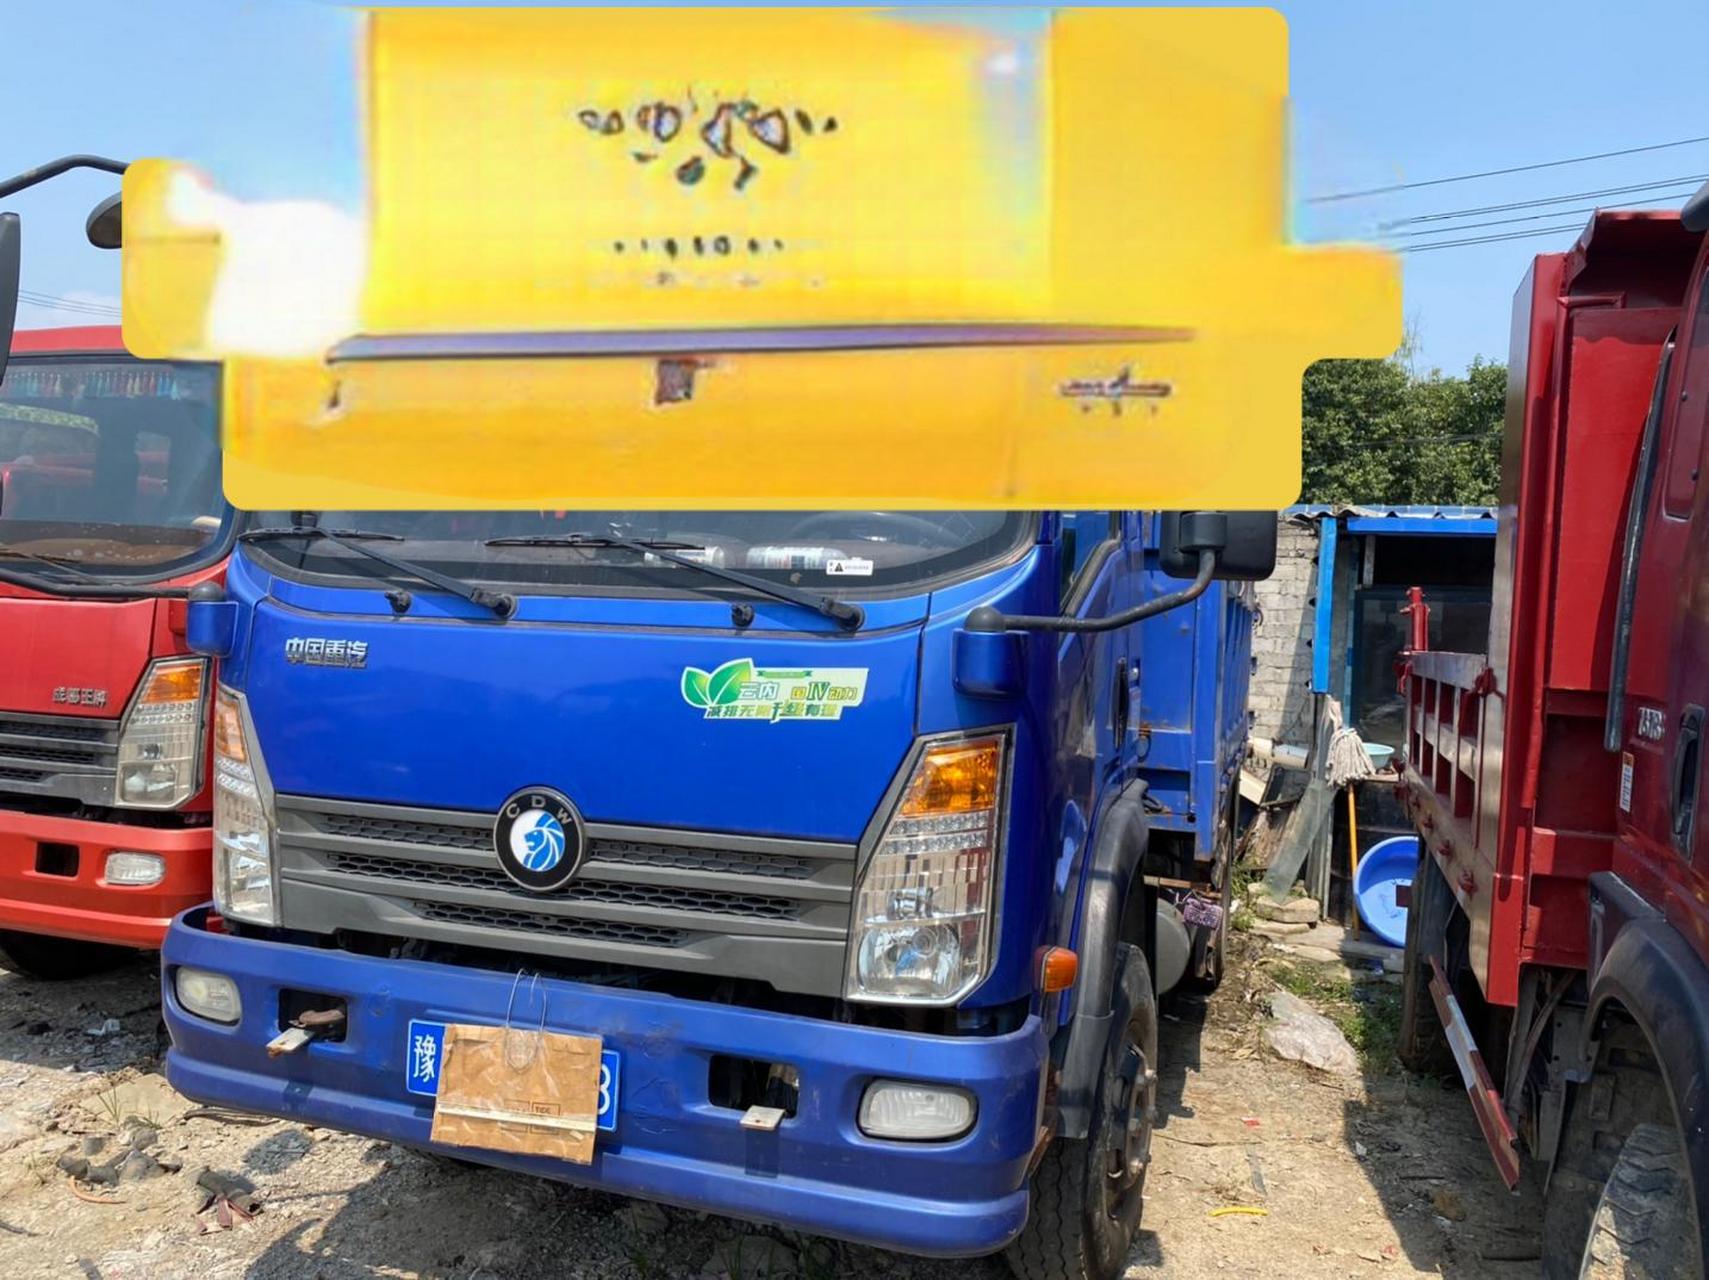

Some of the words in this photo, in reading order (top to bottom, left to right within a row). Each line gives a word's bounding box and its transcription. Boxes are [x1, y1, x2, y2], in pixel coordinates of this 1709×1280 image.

[285, 637, 368, 669] 中国重汽
[506, 795, 572, 824] CDW
